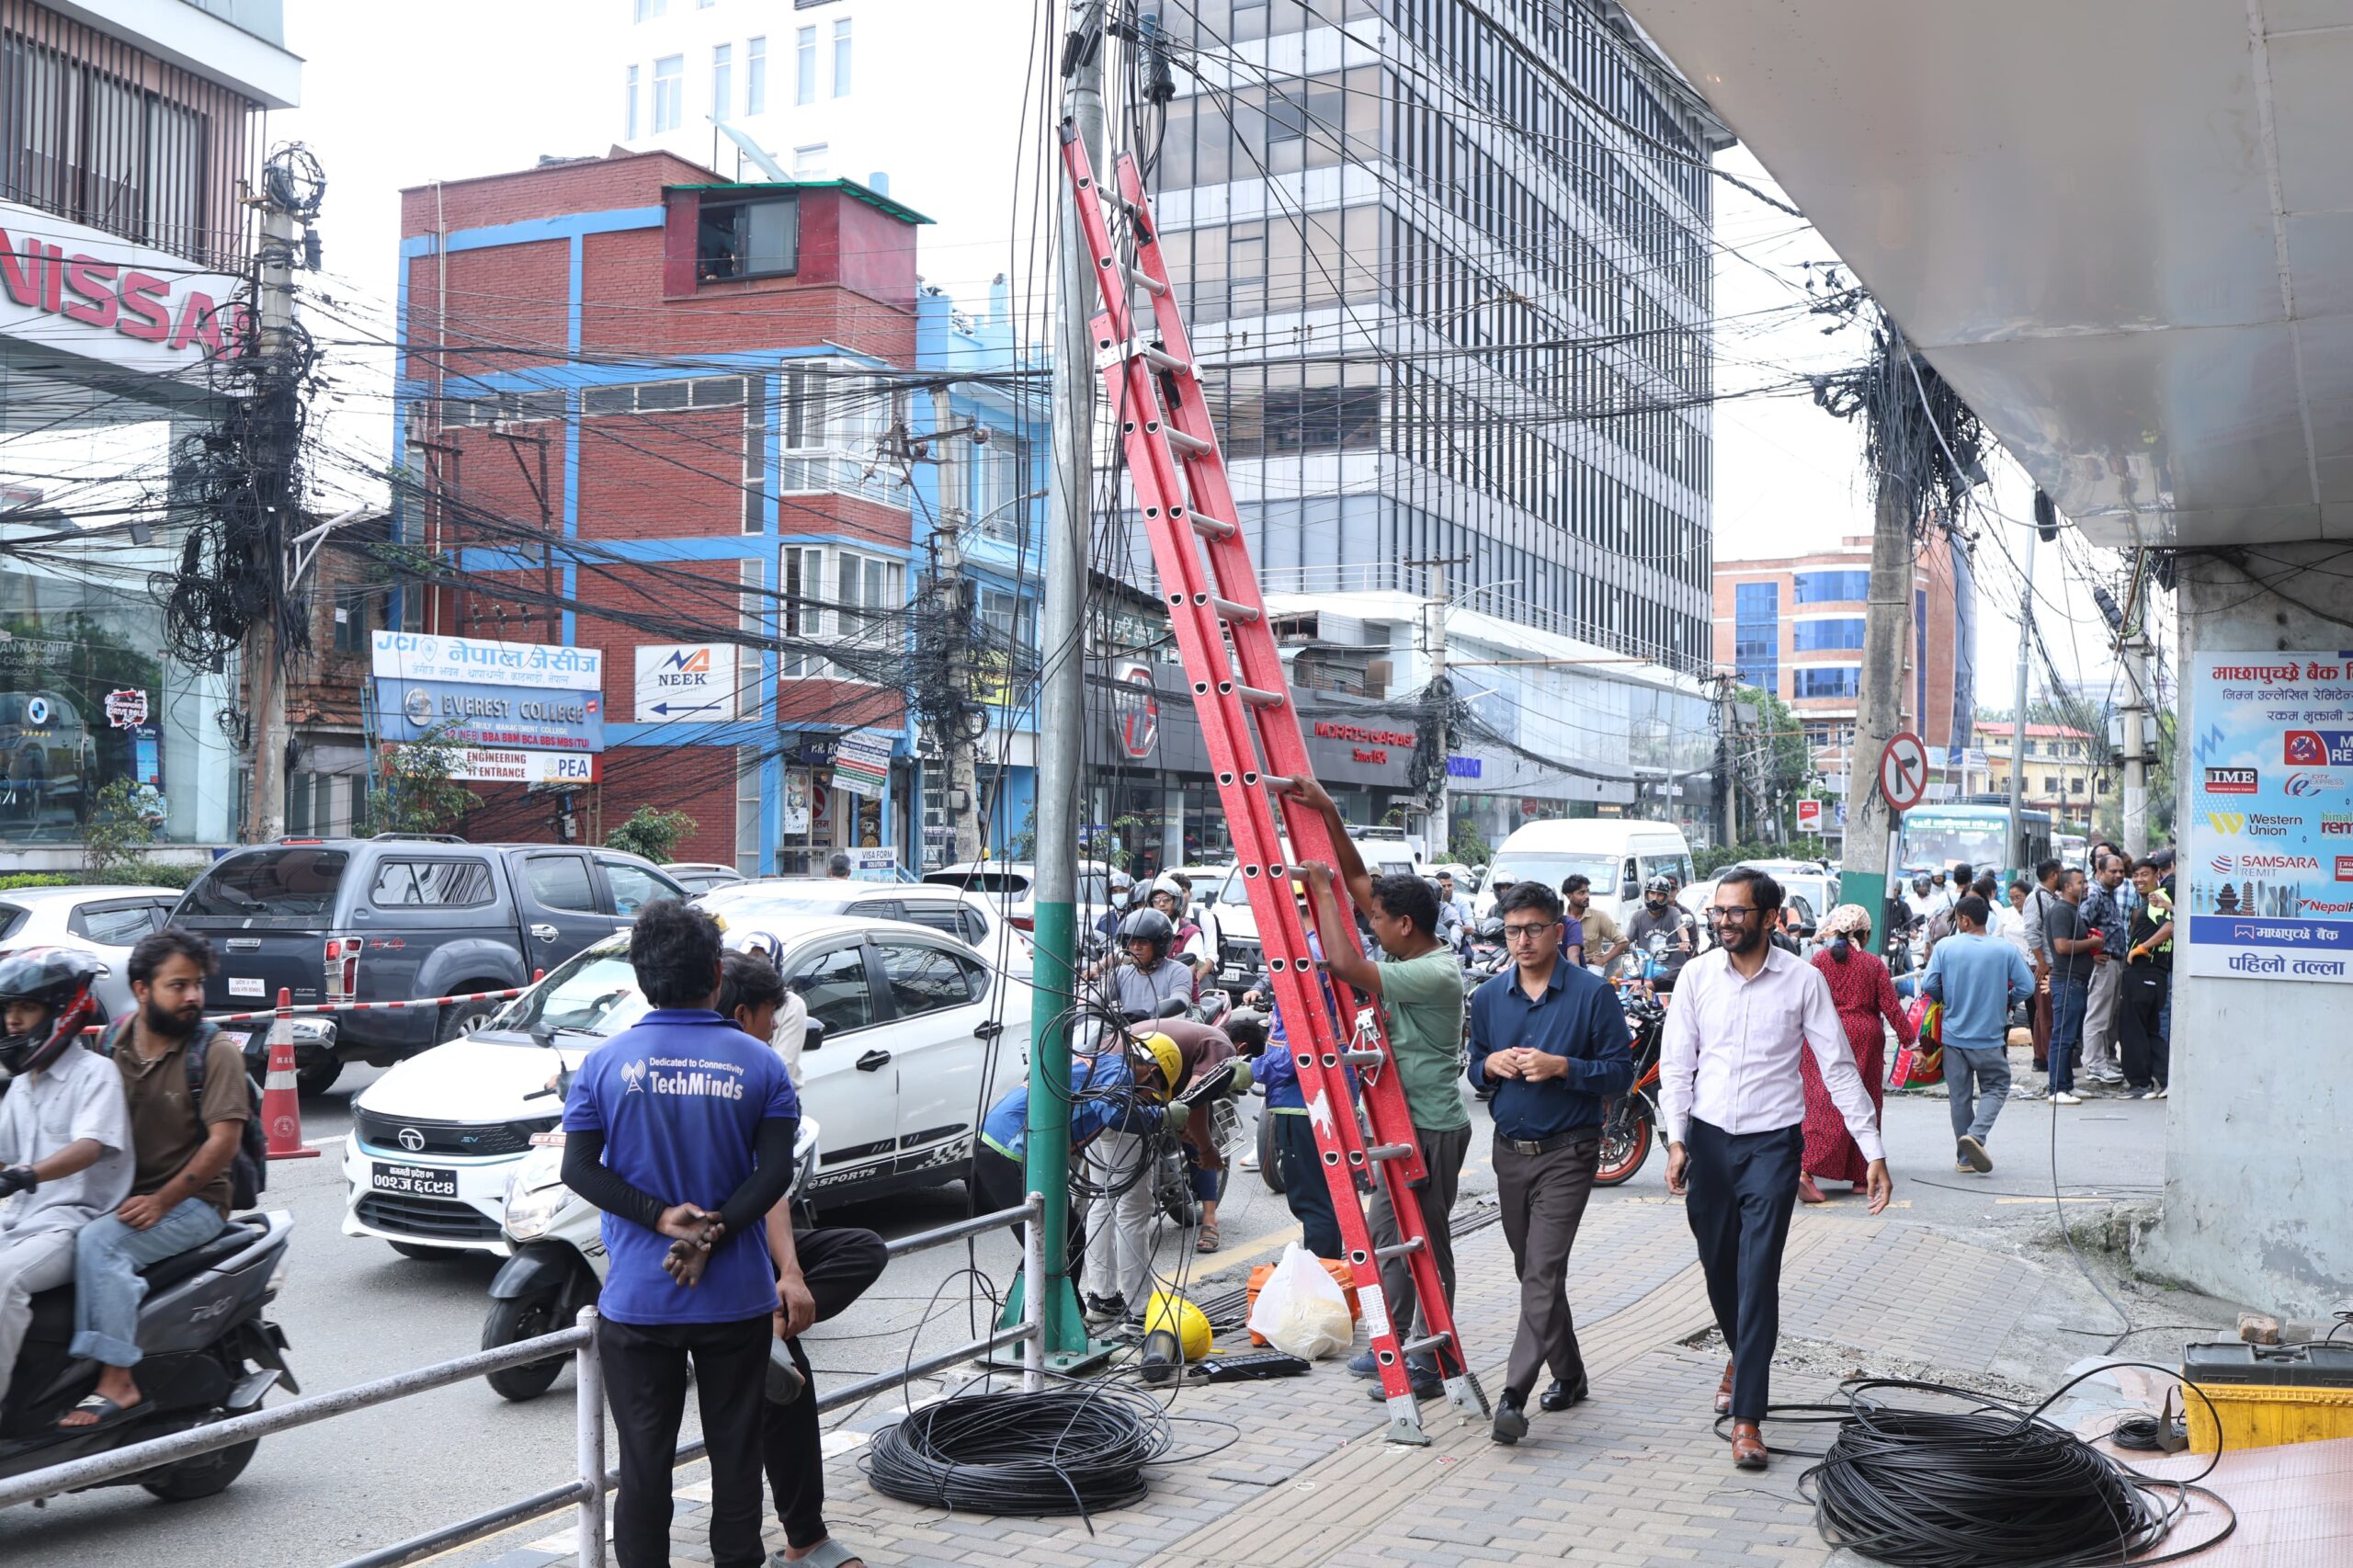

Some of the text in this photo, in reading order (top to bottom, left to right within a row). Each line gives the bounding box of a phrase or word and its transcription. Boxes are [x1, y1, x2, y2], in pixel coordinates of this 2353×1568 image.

[377, 634, 417, 652] JCI
[449, 641, 597, 674] नेपाल जेसीज
[658, 674, 708, 687] NEEK
[441, 695, 510, 719] EVEREST
[519, 701, 584, 724] COLLEGE
[2267, 710, 2299, 722] रकम
[495, 723, 539, 733] MANAGEMENT
[540, 727, 569, 735] COLLEGE
[1314, 722, 1369, 743] MORRIS
[483, 732, 500, 743] BBA
[501, 733, 519, 744] BBM
[522, 734, 539, 745] BCA
[540, 735, 557, 746] BBS
[467, 752, 527, 764] ENGINEERING
[480, 767, 526, 778] ENTRANCE
[559, 759, 588, 778] PEA
[2213, 771, 2255, 783] IME
[2249, 813, 2302, 825] Western
[2249, 824, 2287, 835] Union
[862, 849, 892, 859] VISA FORM
[2242, 855, 2319, 869] SAMSARA
[2241, 868, 2278, 878] REMIT
[2228, 952, 2346, 975] पहिलो तल्ला
[649, 1057, 744, 1076] Dedicated to Connectivity
[649, 1071, 744, 1100] TechMinds
[818, 1167, 878, 1187] SPORTS
